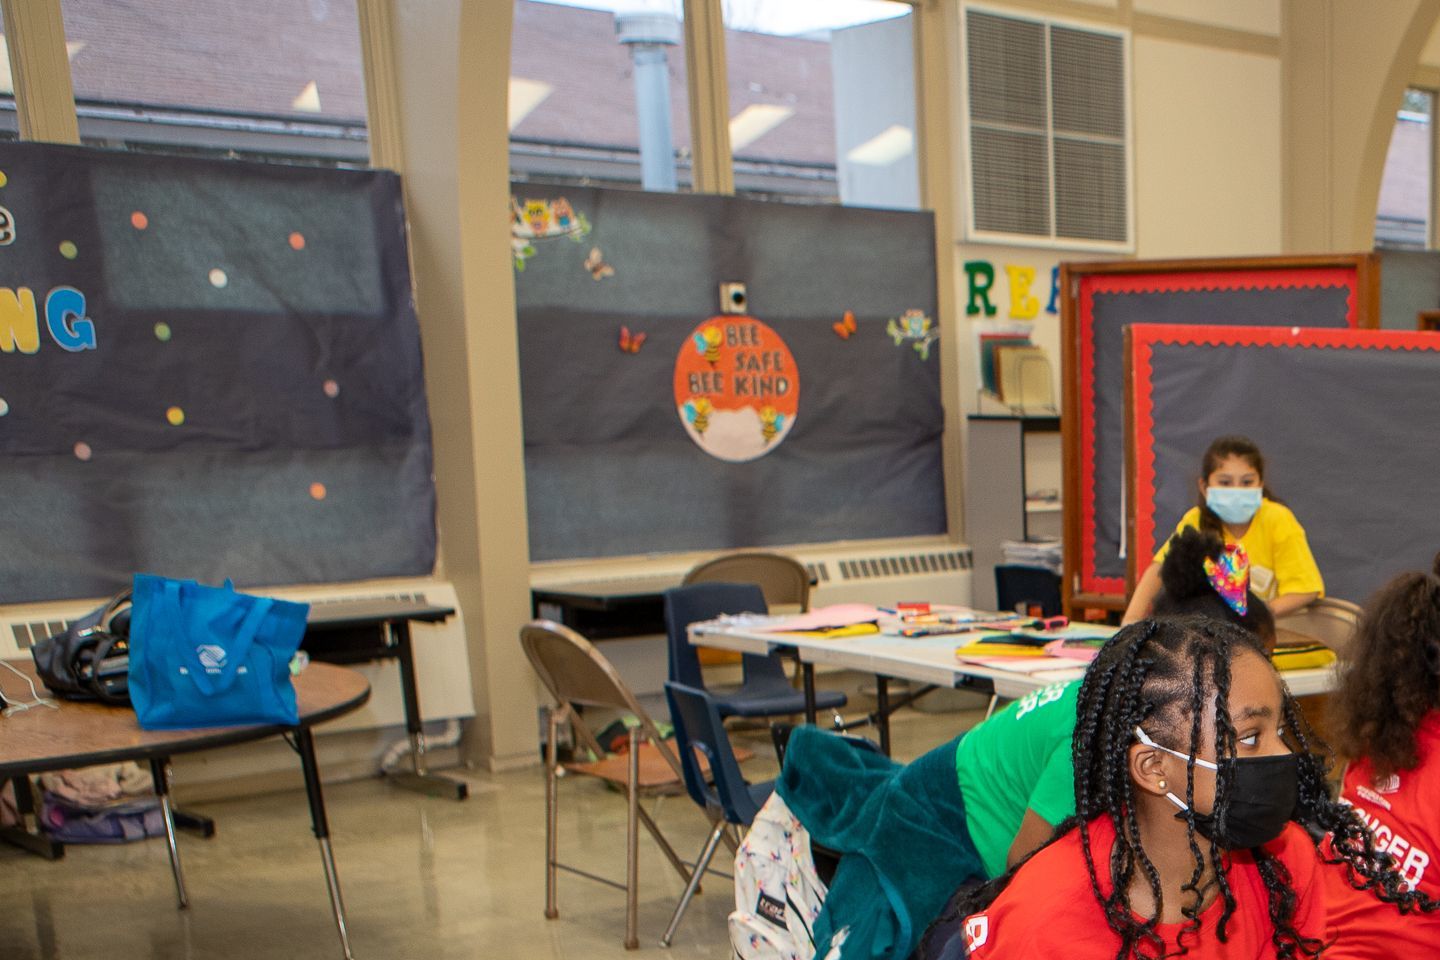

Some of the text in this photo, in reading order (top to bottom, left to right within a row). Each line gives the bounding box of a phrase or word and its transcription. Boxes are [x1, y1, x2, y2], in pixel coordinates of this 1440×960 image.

[726, 324, 760, 348] BEE
[735, 351, 783, 372] SAFE
[688, 372, 788, 396] BEE KIND
